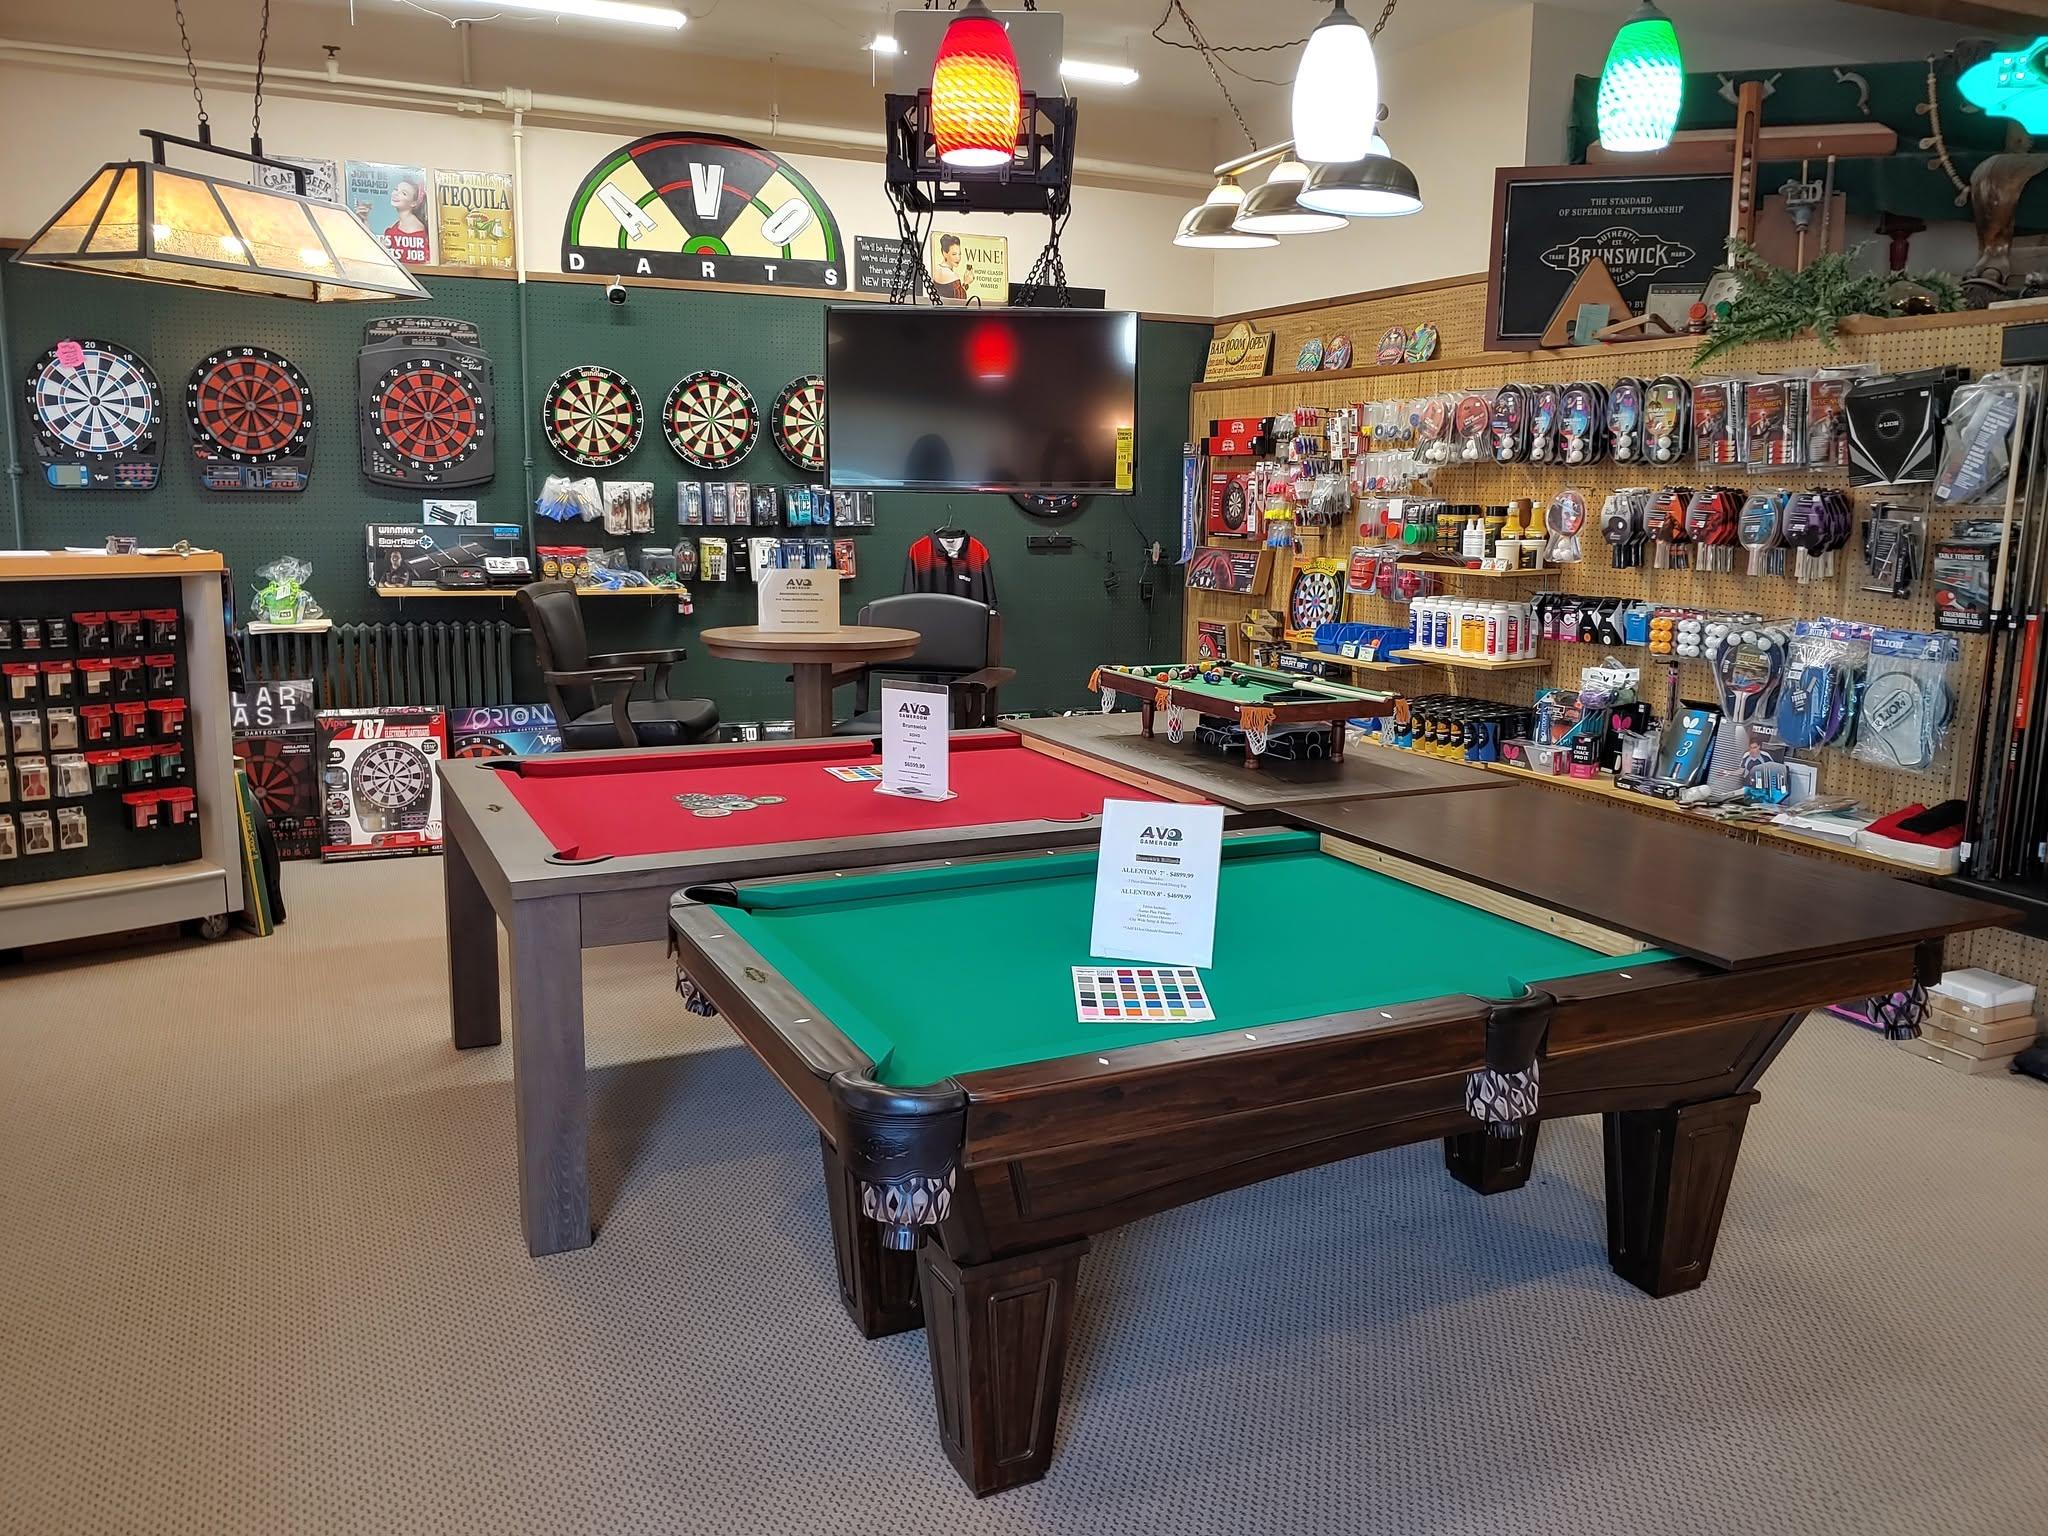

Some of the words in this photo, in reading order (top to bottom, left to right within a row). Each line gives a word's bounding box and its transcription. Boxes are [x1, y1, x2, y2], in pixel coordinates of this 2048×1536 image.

[352, 179, 388, 189] ASHAMED
[440, 185, 510, 211] TEQUILA
[1591, 198, 1607, 206] THE
[1610, 197, 1652, 205] STANDARD
[1572, 208, 1612, 216] SUPERIOR
[1615, 206, 1683, 215] CRAFTSMANSHIP
[394, 235, 424, 248] YOUR
[1597, 230, 1639, 245] AUTHENTIC
[876, 243, 883, 251] be
[407, 250, 424, 260] JOB
[965, 248, 1003, 264] WINE!
[568, 253, 839, 286] DARTS
[869, 264, 883, 274] then
[862, 275, 879, 286] NEW
[1210, 342, 1225, 355] BAR
[1226, 339, 1246, 351] ROOM
[1250, 336, 1268, 350] OPEN
[232, 686, 296, 707] LAR
[233, 706, 296, 727] AST
[473, 706, 548, 729] ORION
[319, 718, 350, 731] Viper
[351, 719, 384, 739] 787
[1676, 741, 1692, 756] 3
